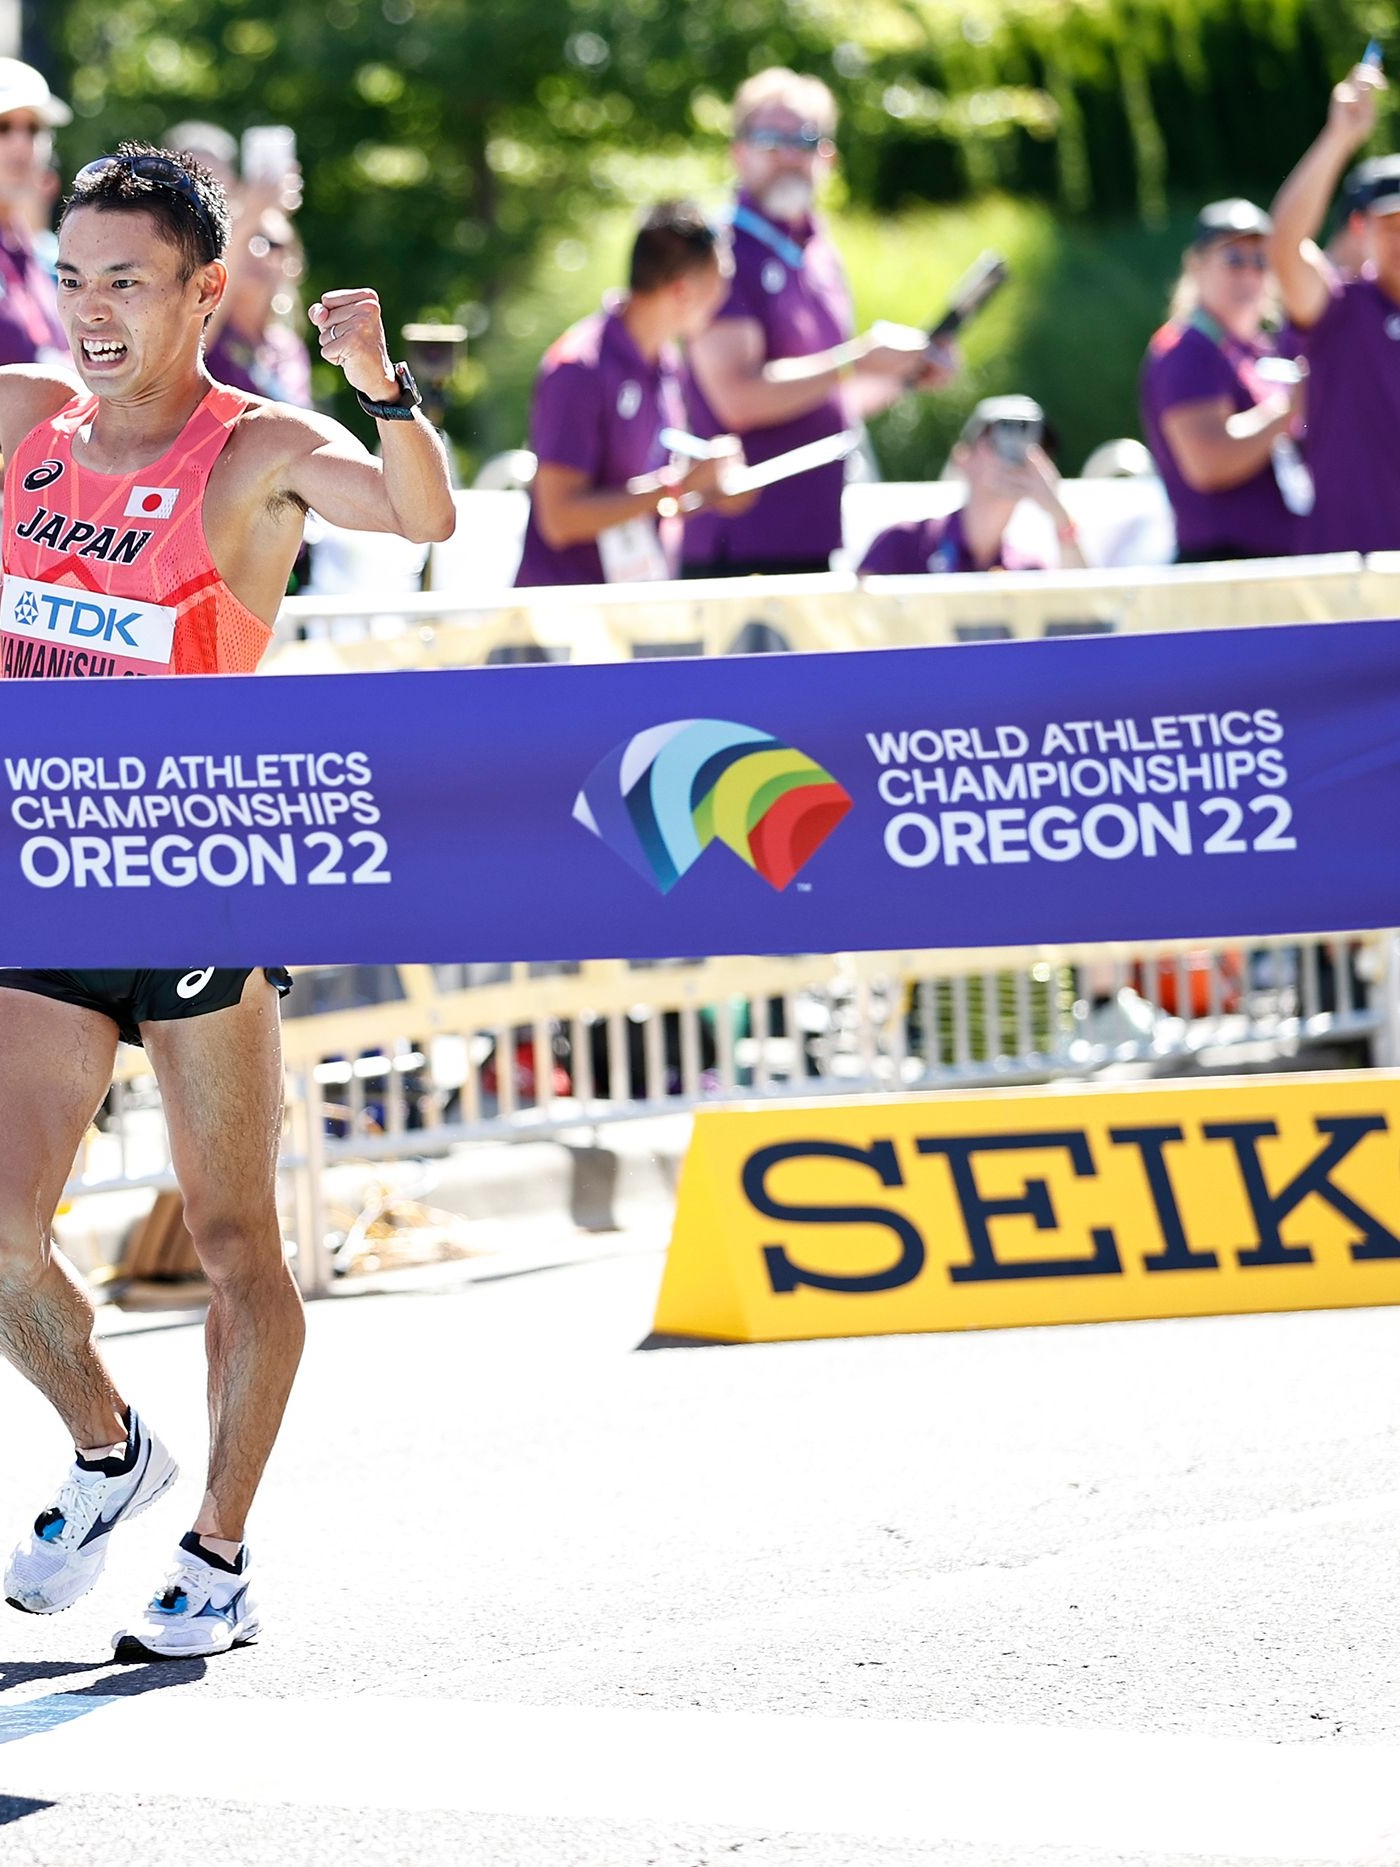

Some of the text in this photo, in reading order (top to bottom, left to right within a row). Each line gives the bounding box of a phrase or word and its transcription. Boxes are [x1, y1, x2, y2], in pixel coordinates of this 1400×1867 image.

[16, 508, 153, 565] JAPAN
[41, 595, 143, 647] TDK
[867, 710, 1283, 764] WORLD ATHLETICS
[5, 752, 372, 790] WORLD ATHLETICS
[878, 749, 1287, 805] CHAMPIONSHIPS
[11, 791, 380, 830] CHAMPIONSHIPS
[741, 1115, 1400, 1293] SEIK
